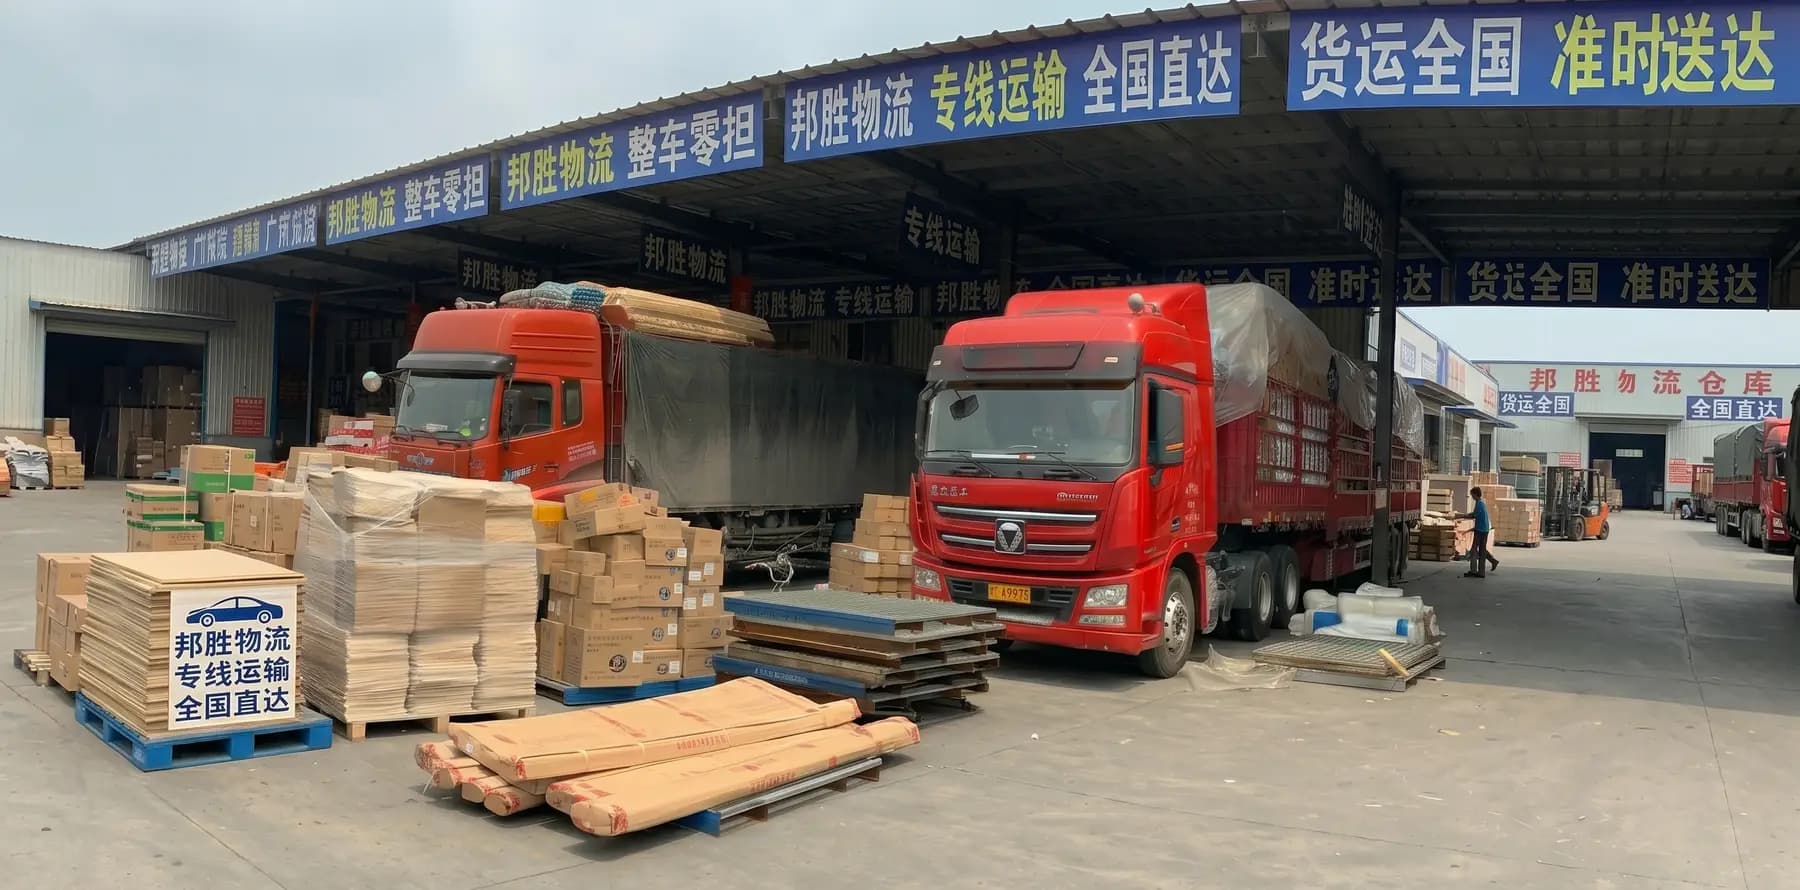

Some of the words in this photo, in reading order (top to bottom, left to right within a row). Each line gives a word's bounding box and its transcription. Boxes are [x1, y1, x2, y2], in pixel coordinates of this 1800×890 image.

[1301, 17, 1522, 100] 货运全国
[1551, 11, 1776, 96] 准时送达
[791, 72, 914, 152] 邦胜物流
[930, 49, 1068, 131] 专线运输
[1083, 31, 1233, 114] 全国直达
[507, 132, 614, 202] 邦胜物流
[627, 104, 756, 179] 整车零担
[328, 185, 396, 239] 邦胜物流
[404, 164, 485, 222] 整车零担
[904, 205, 981, 265] 专线运输
[644, 232, 728, 285] 邦胜物流
[753, 288, 826, 319] 邦胜物流
[835, 283, 914, 316] 专线运输
[937, 278, 1031, 312] 邦胜物
[1467, 261, 1599, 303] 货运全国
[1620, 262, 1758, 304] 准时送达
[1500, 392, 1570, 415] 货运全国
[1691, 398, 1778, 420] 全国直达
[174, 625, 291, 660] 邦胜物流
[174, 656, 290, 689] 专线运输
[174, 686, 290, 722] 全国直达
